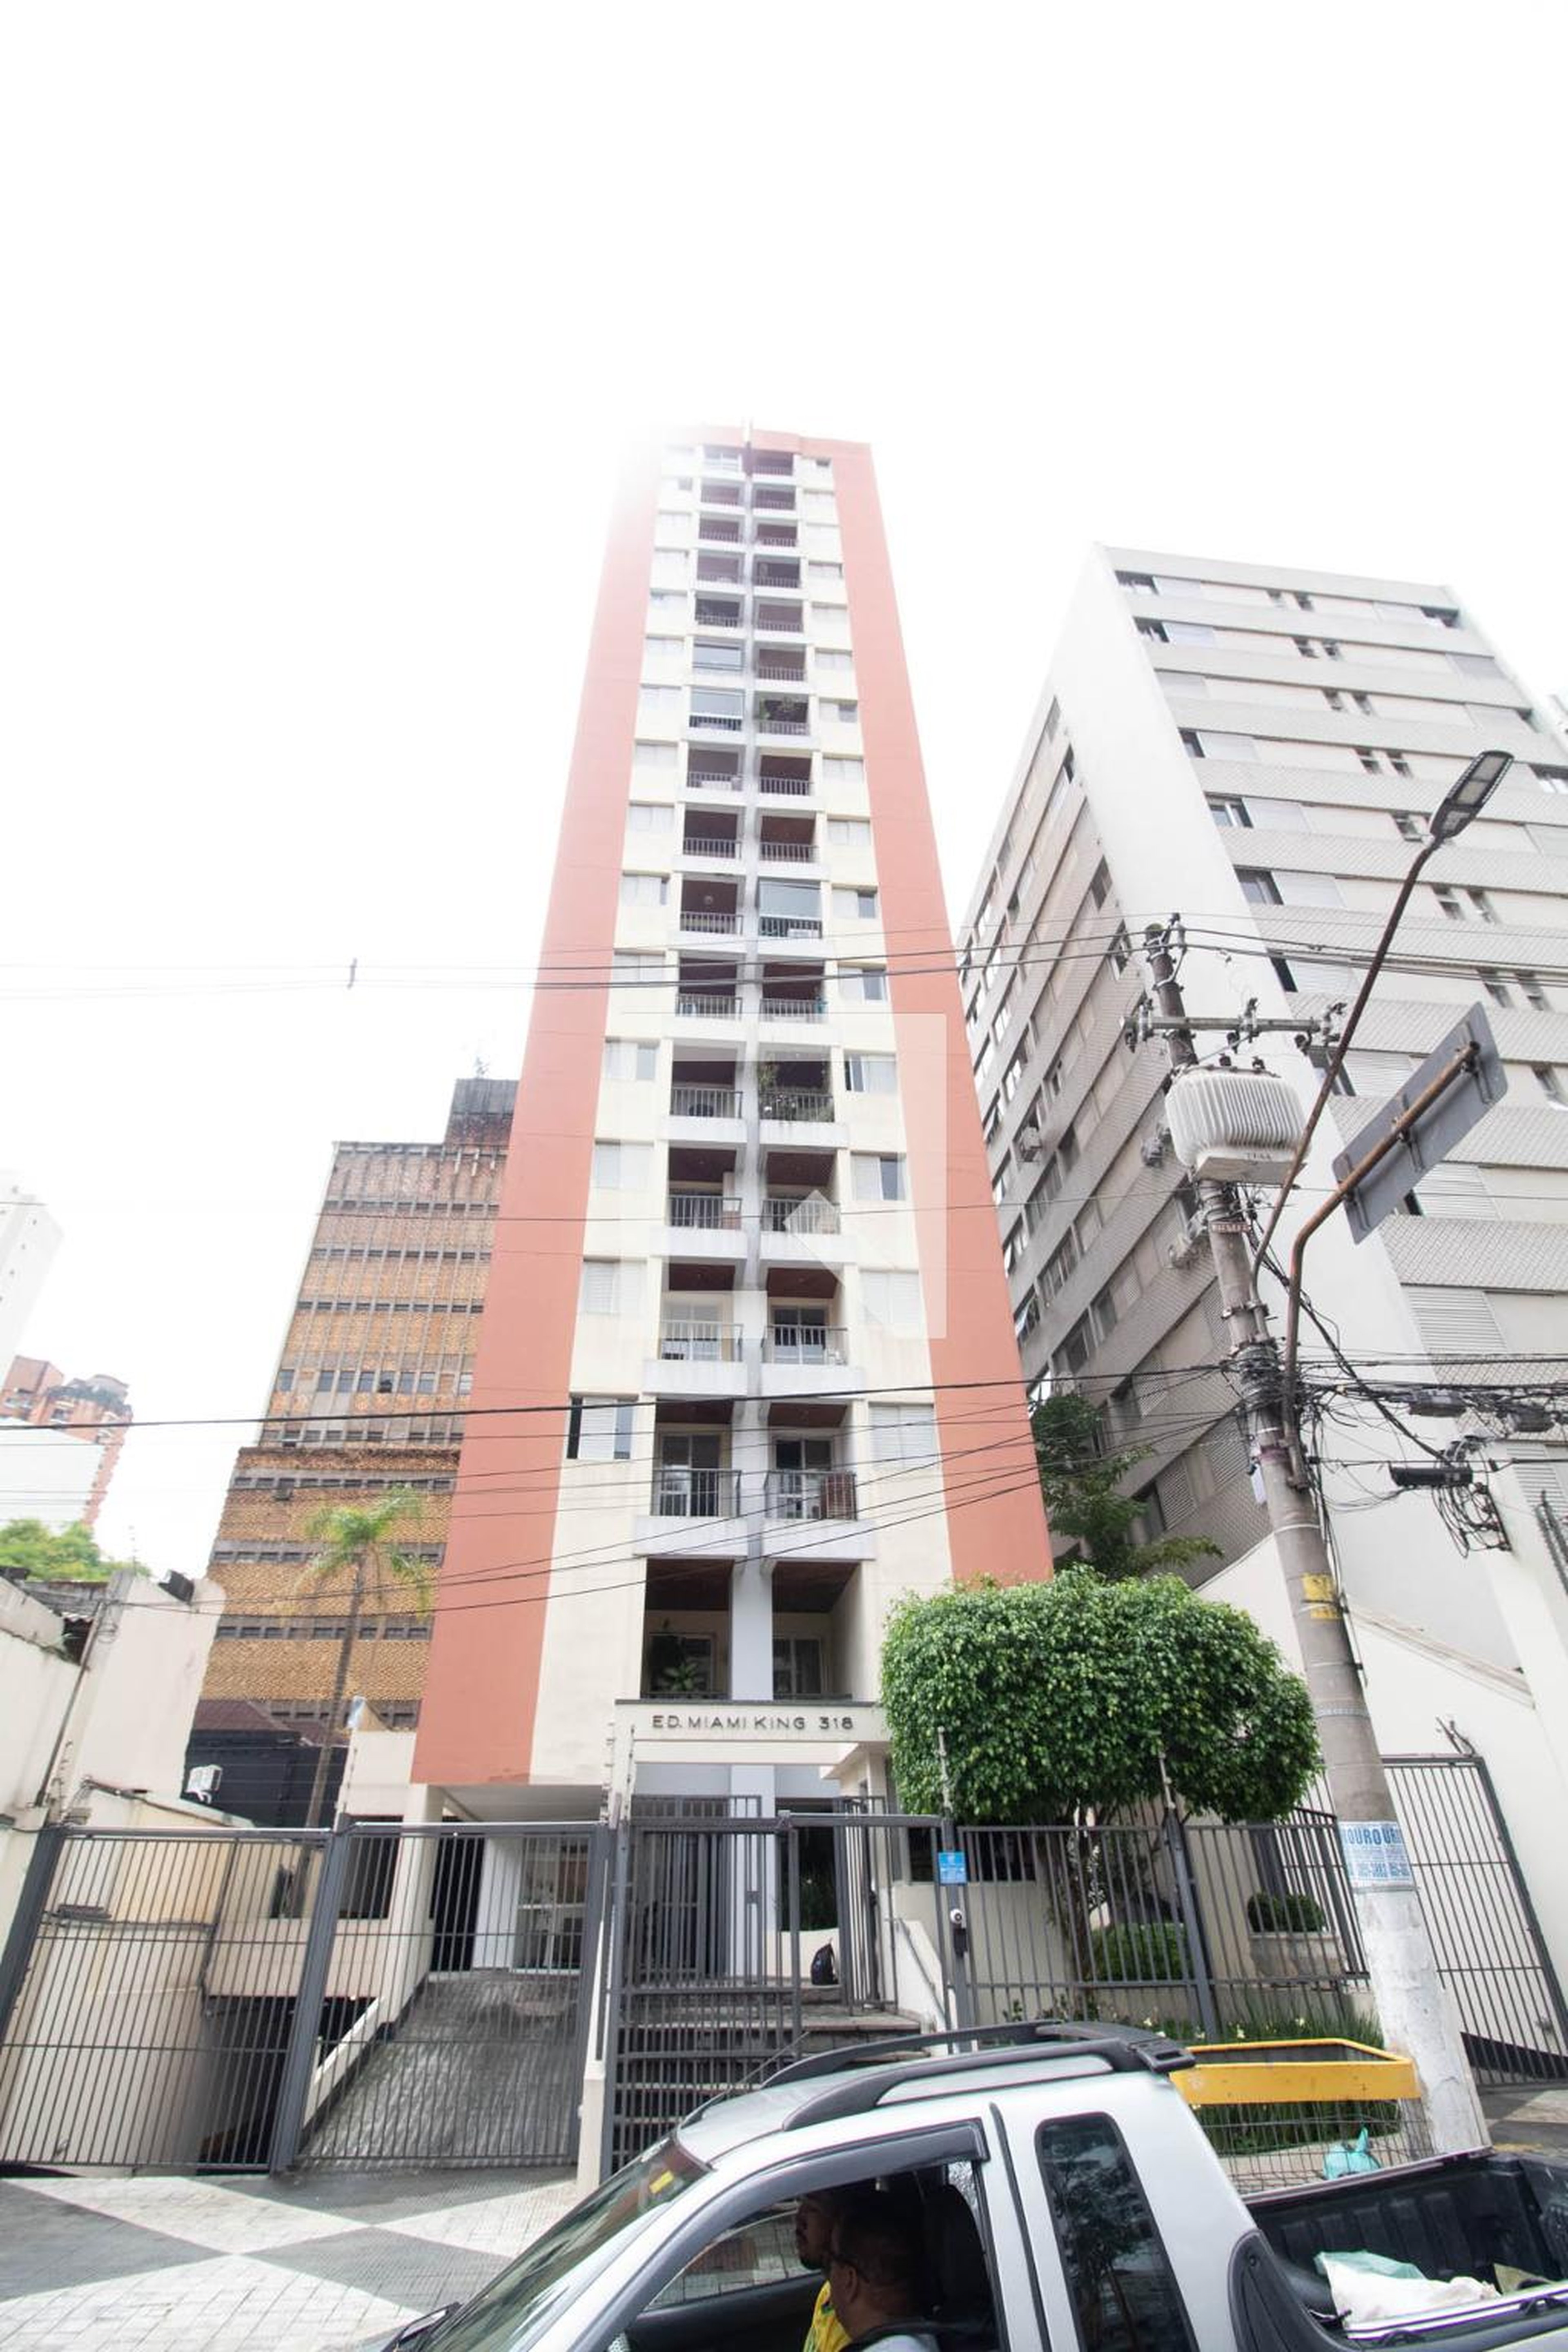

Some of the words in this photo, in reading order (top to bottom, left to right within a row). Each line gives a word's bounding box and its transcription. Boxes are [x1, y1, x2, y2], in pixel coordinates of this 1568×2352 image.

[652, 1715, 683, 1728] ED.
[688, 1716, 747, 1730] MIAMI
[755, 1716, 805, 1730] KING
[819, 1716, 853, 1730] 318
